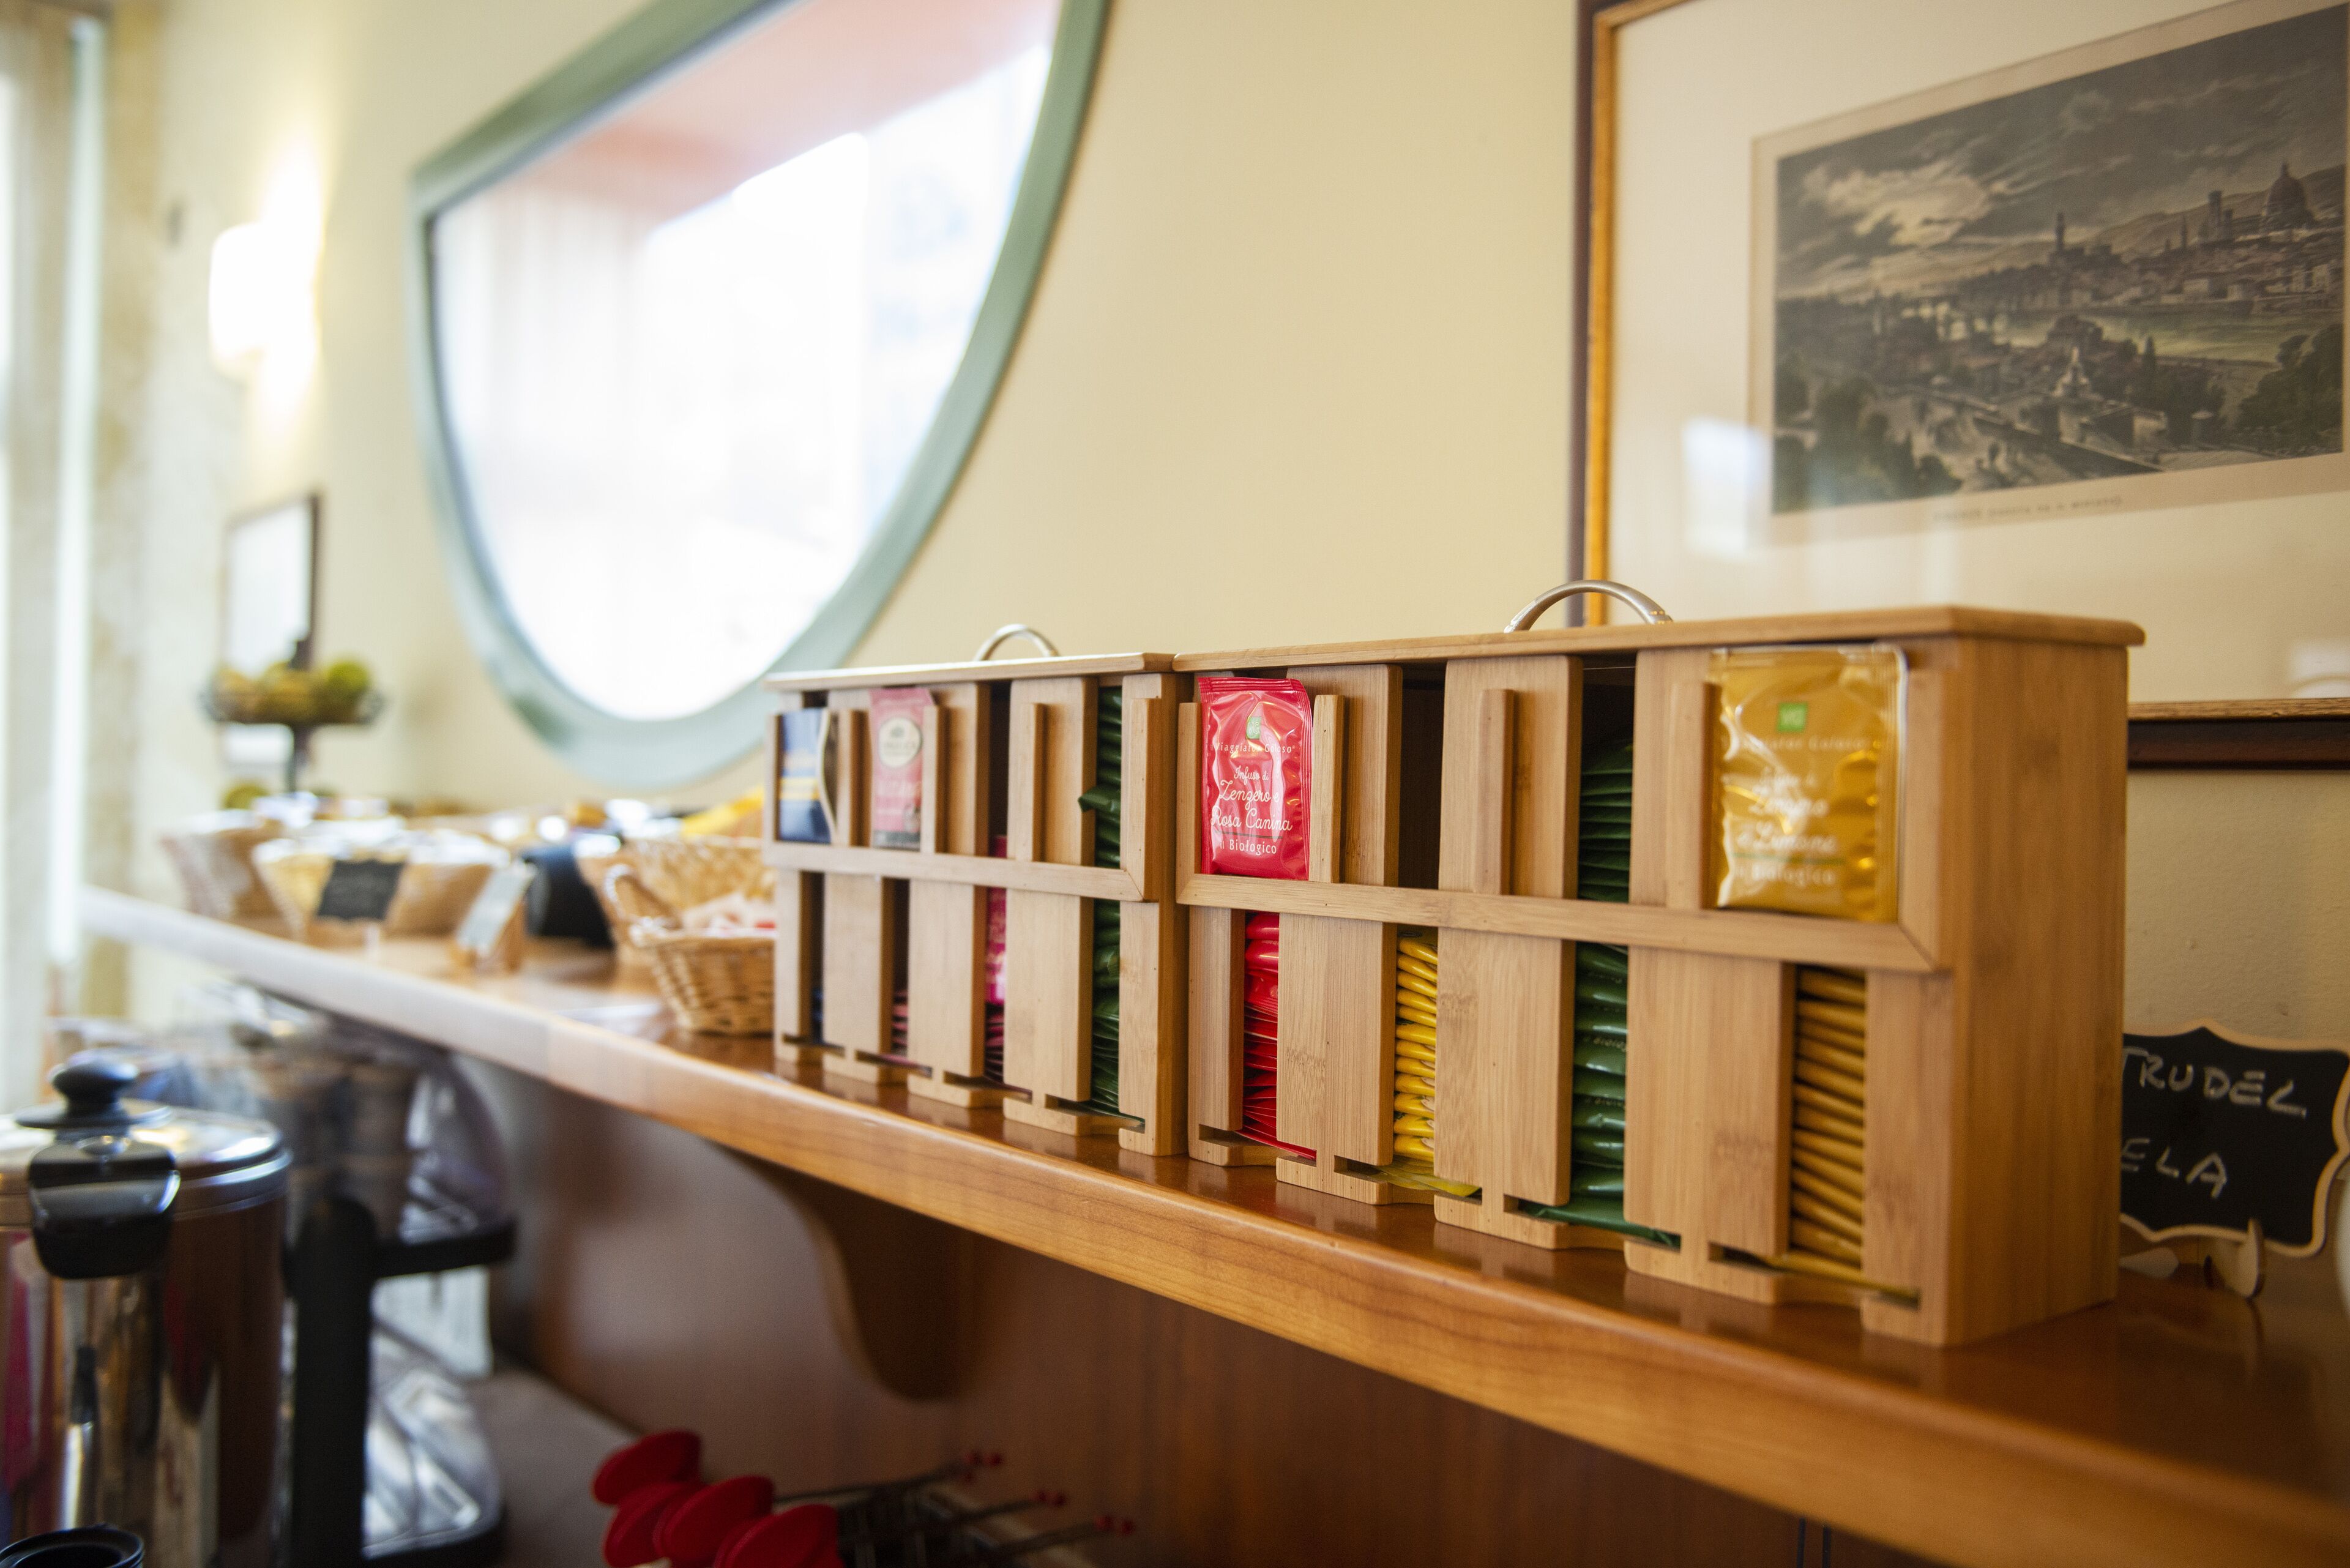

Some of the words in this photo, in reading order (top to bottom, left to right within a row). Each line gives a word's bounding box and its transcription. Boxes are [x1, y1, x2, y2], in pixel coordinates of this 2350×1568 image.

[1234, 766, 1260, 785] Infuso
[1262, 771, 1269, 780] di
[1219, 780, 1271, 810] Zenzero
[1274, 791, 1279, 803] e
[1210, 805, 1242, 827] Rosa
[1245, 808, 1292, 831] Canina
[1229, 839, 1277, 856] Biologico
